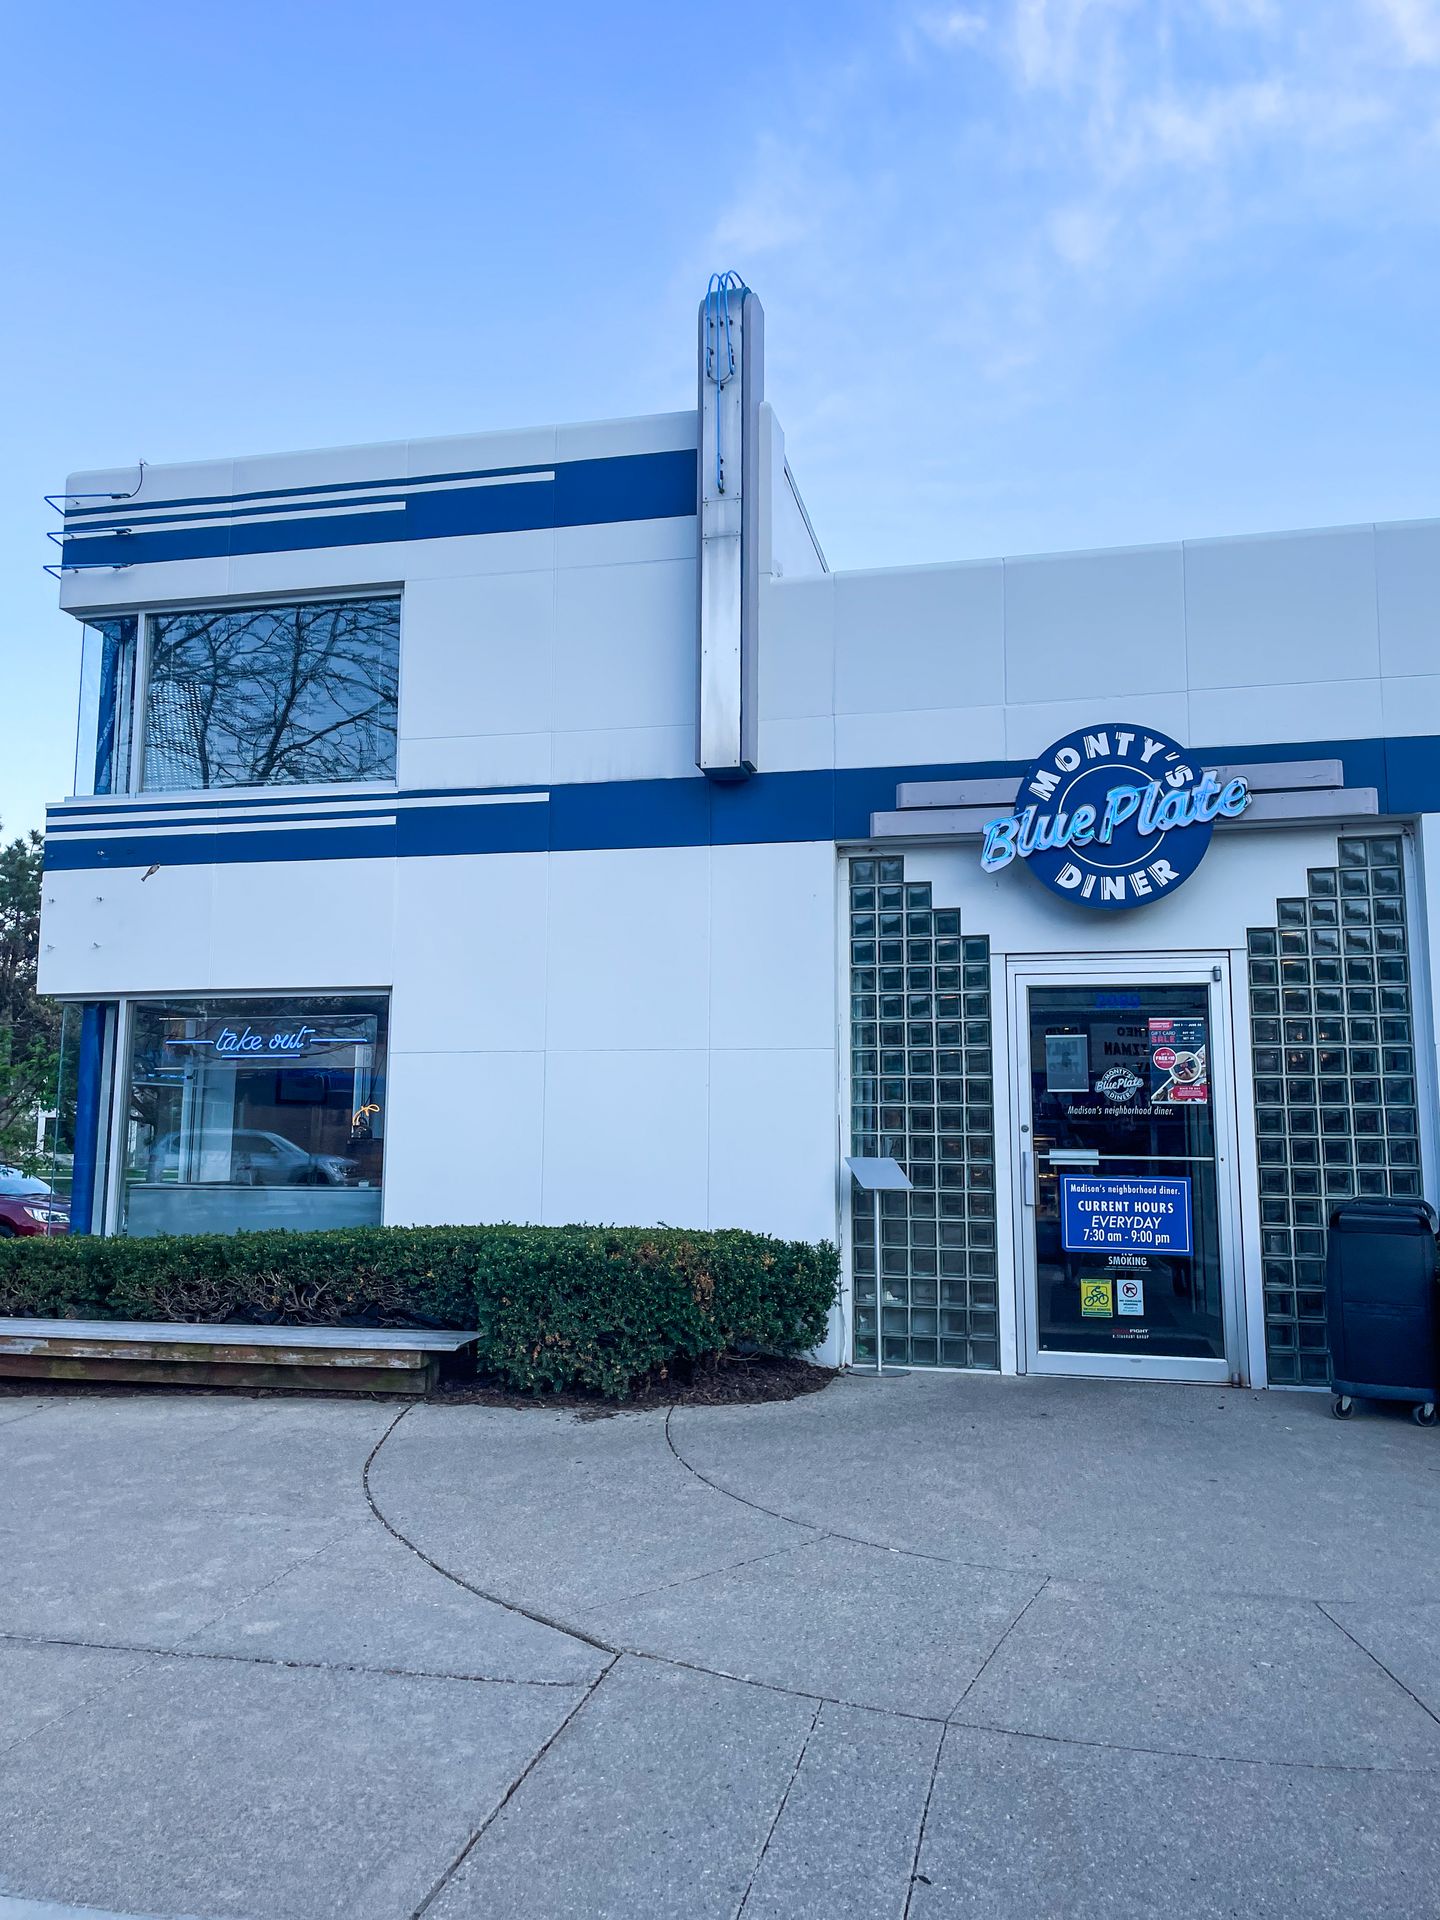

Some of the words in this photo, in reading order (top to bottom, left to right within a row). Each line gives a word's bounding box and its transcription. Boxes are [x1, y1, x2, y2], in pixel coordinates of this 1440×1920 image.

[1029, 732, 1194, 801] MONTY'S
[980, 805, 1097, 873] Blue
[1099, 769, 1252, 844] Plate
[1054, 859, 1180, 900] DINER
[216, 1026, 262, 1051] take
[269, 1025, 316, 1049] out
[1104, 1068, 1132, 1080] MONTY'S
[1095, 1080, 1118, 1093] Blue
[1117, 1077, 1144, 1089] Plate
[1110, 1092, 1131, 1100] DINER
[1067, 1105, 1102, 1115] Madison's
[1104, 1105, 1152, 1116] neighborhood
[1154, 1107, 1174, 1115] diner.
[1070, 1184, 1105, 1193] Madison's
[1107, 1184, 1157, 1195] neighborhood
[1159, 1185, 1180, 1195] diner.
[1078, 1200, 1129, 1212] CURRENT
[1134, 1201, 1174, 1214] HOURS
[1091, 1215, 1162, 1229] EVERYDAY
[1083, 1229, 1105, 1241] 7:30
[1107, 1232, 1122, 1241] am
[1131, 1230, 1153, 1243] 9:00
[1155, 1234, 1170, 1246] pm
[1108, 1256, 1147, 1266] SMOKING
